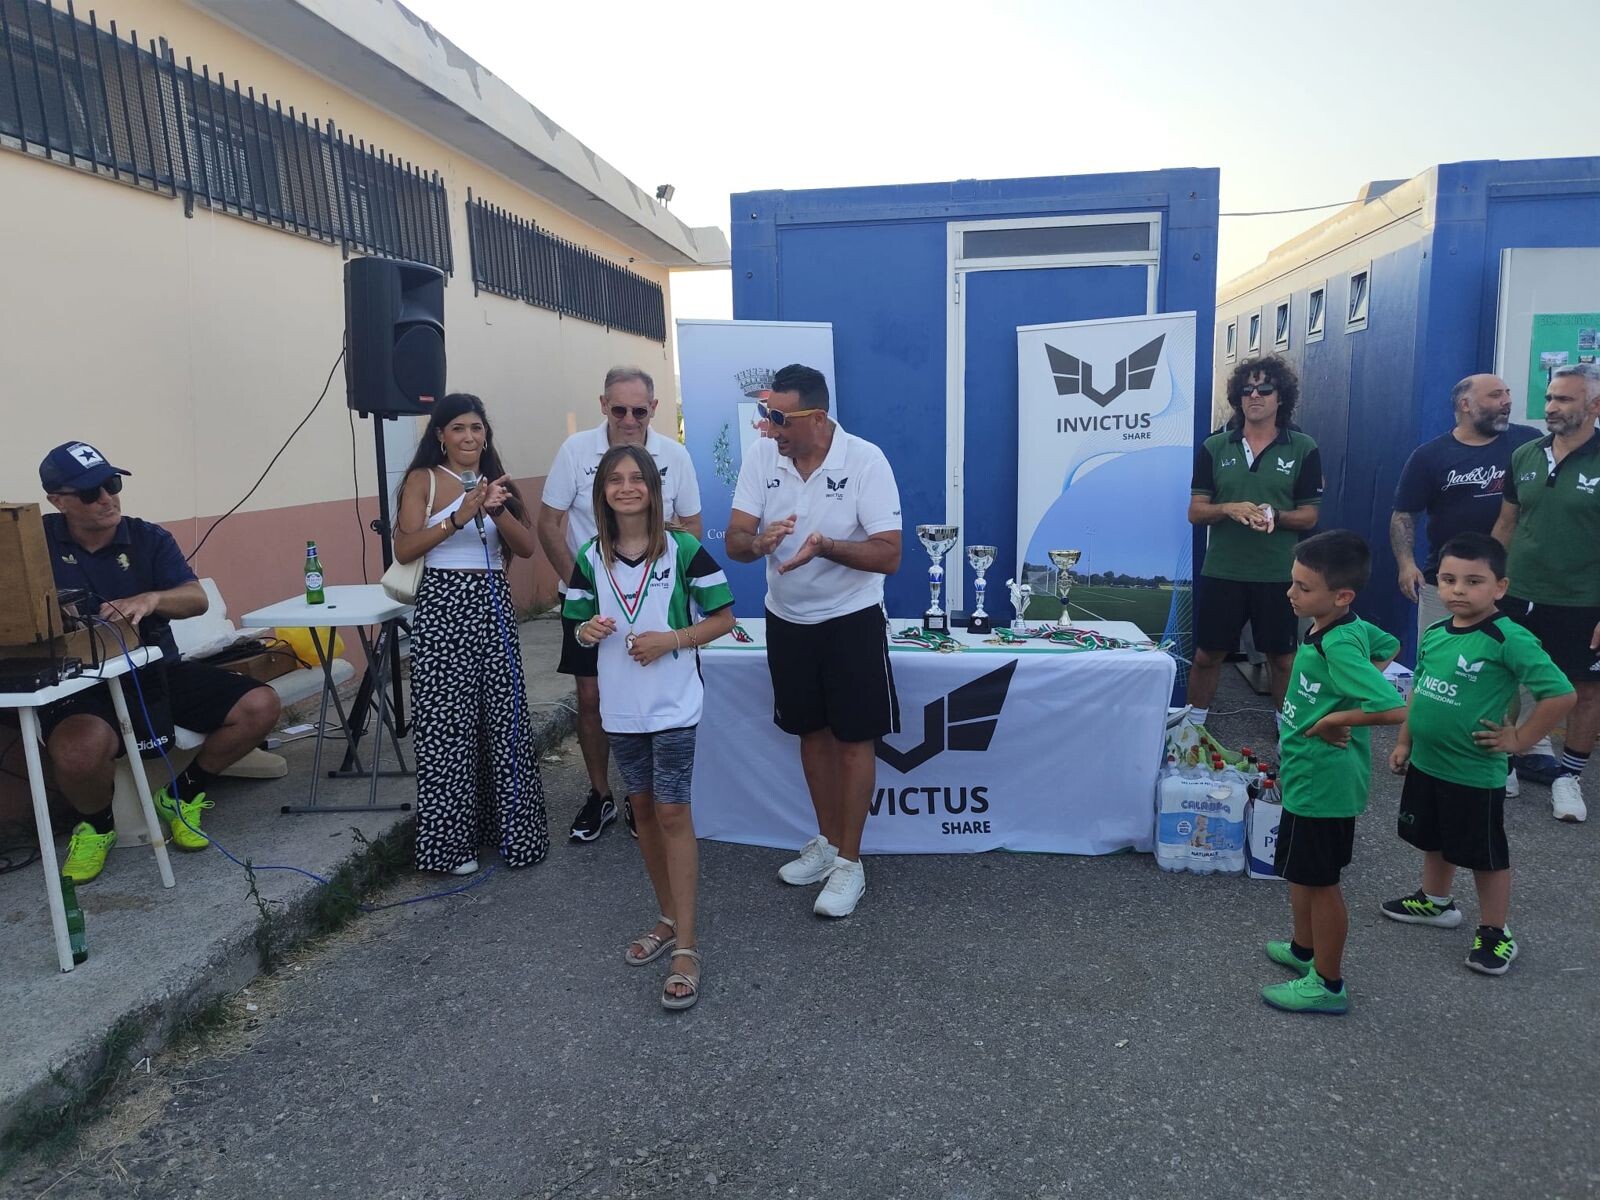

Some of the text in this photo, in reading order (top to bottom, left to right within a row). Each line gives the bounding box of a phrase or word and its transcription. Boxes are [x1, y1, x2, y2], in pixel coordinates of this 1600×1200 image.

[1057, 412, 1151, 433] INVICTUS
[1122, 431, 1151, 441] SHARE
[1423, 675, 1458, 697] NEOS
[136, 735, 169, 750] didas
[868, 786, 989, 816] VICTUS
[941, 820, 991, 834] SHARE
